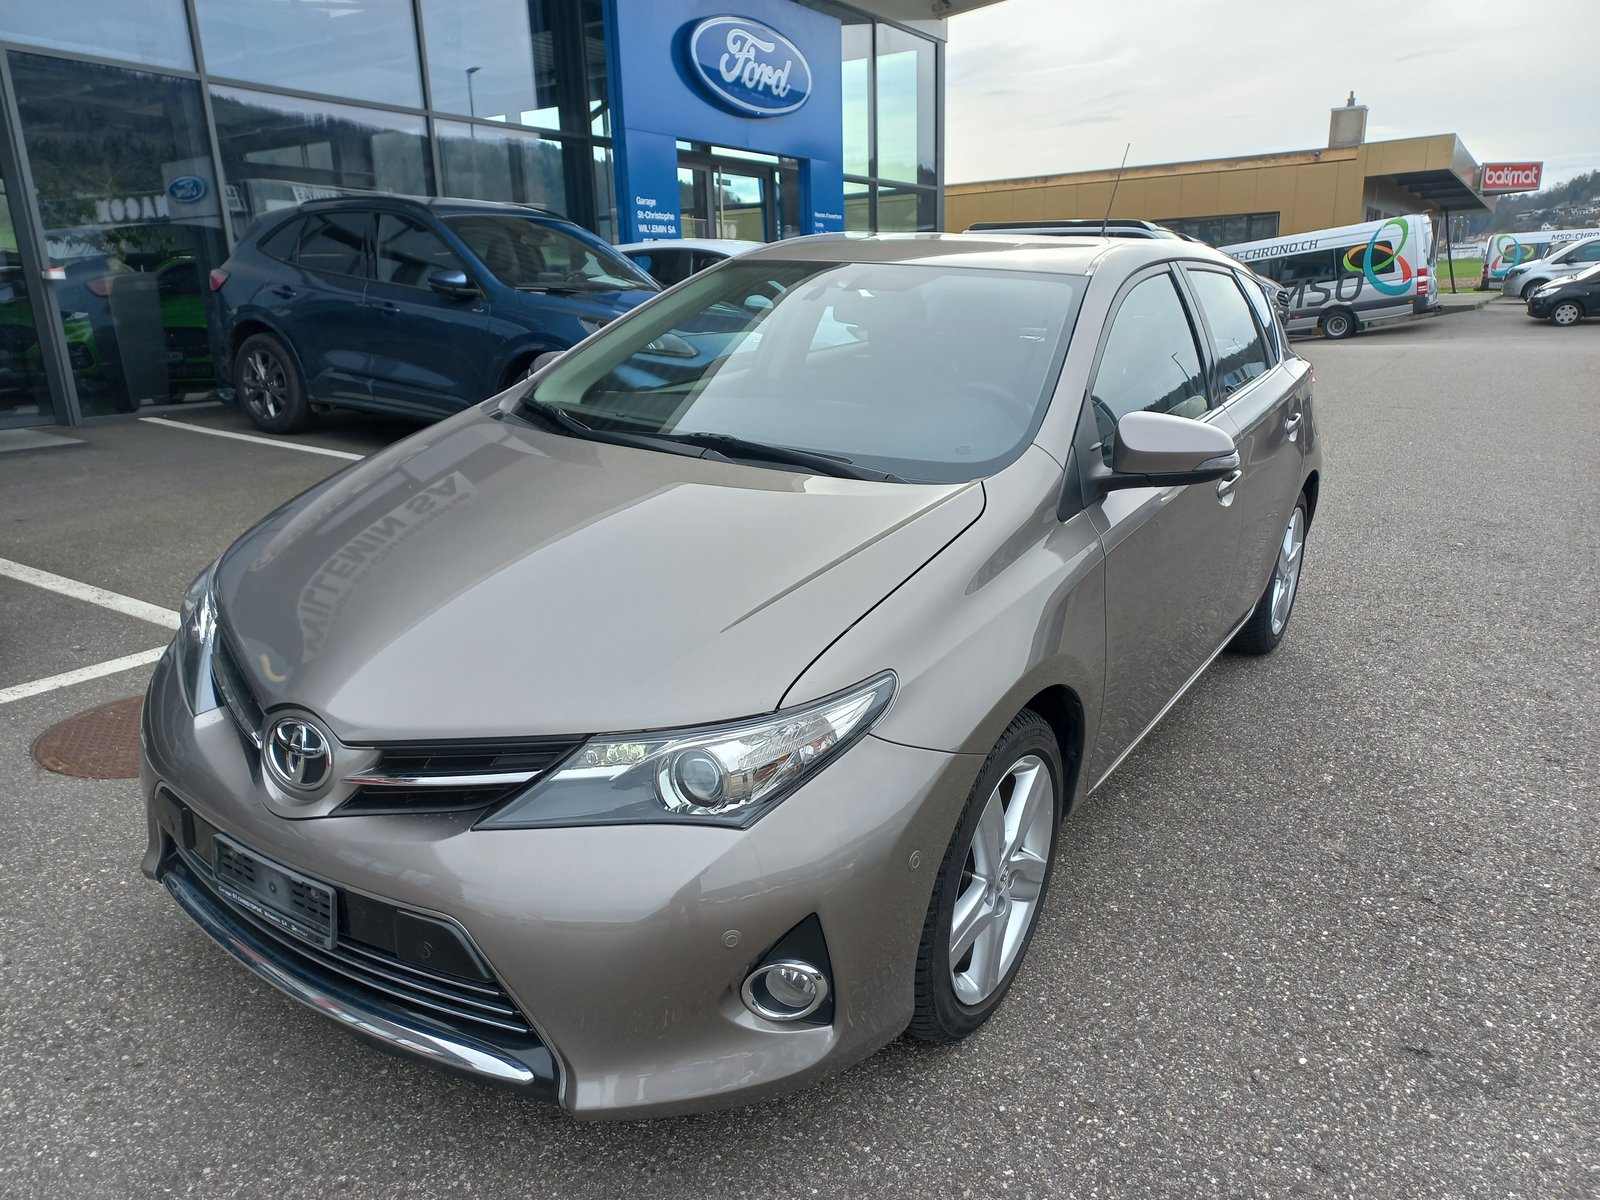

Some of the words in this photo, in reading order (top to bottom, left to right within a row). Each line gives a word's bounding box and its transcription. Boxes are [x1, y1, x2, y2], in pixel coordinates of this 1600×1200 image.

[719, 28, 792, 98] Ford
[1485, 164, 1538, 187] batimat
[635, 196, 657, 207] Garage
[637, 210, 675, 221] St-Christophe
[637, 224, 667, 233] WILLEMIN
[667, 225, 677, 233] SA
